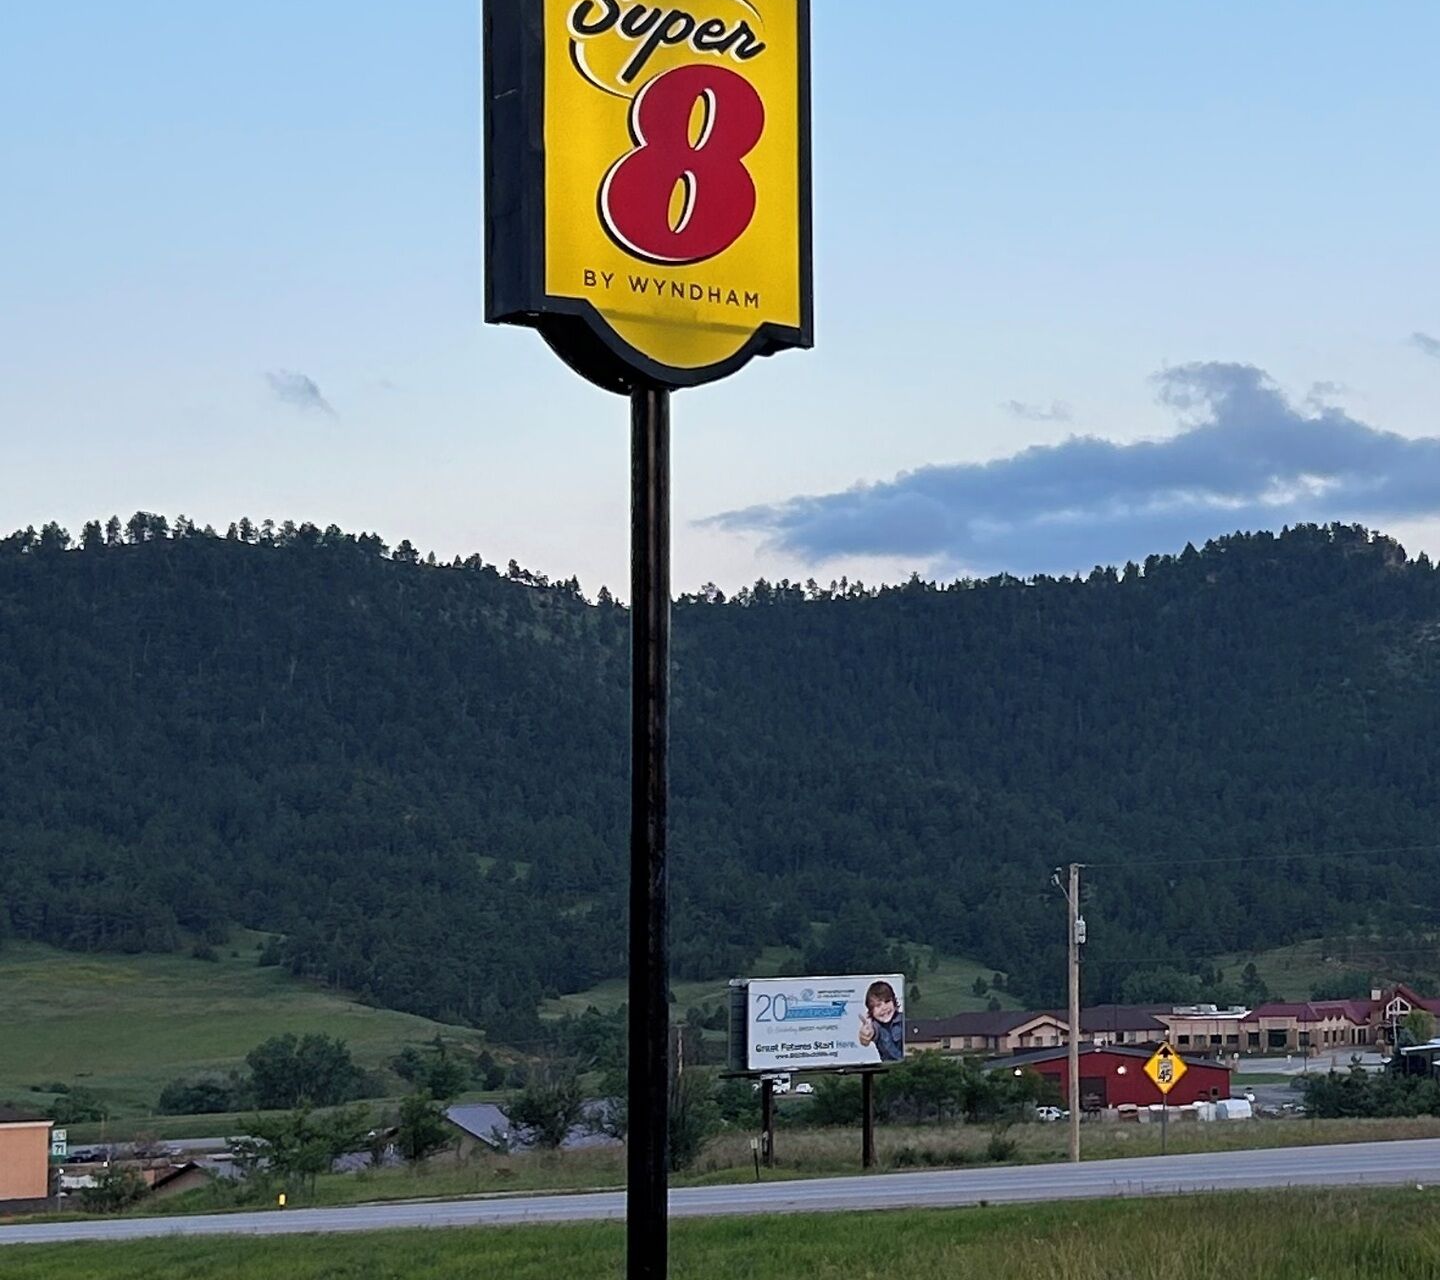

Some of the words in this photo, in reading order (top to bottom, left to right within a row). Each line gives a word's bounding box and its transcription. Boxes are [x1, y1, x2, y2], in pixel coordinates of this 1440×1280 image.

[597, 63, 766, 266] 8
[583, 269, 615, 289] BY
[628, 275, 760, 309] WYNDHAM
[755, 993, 788, 1022] 20
